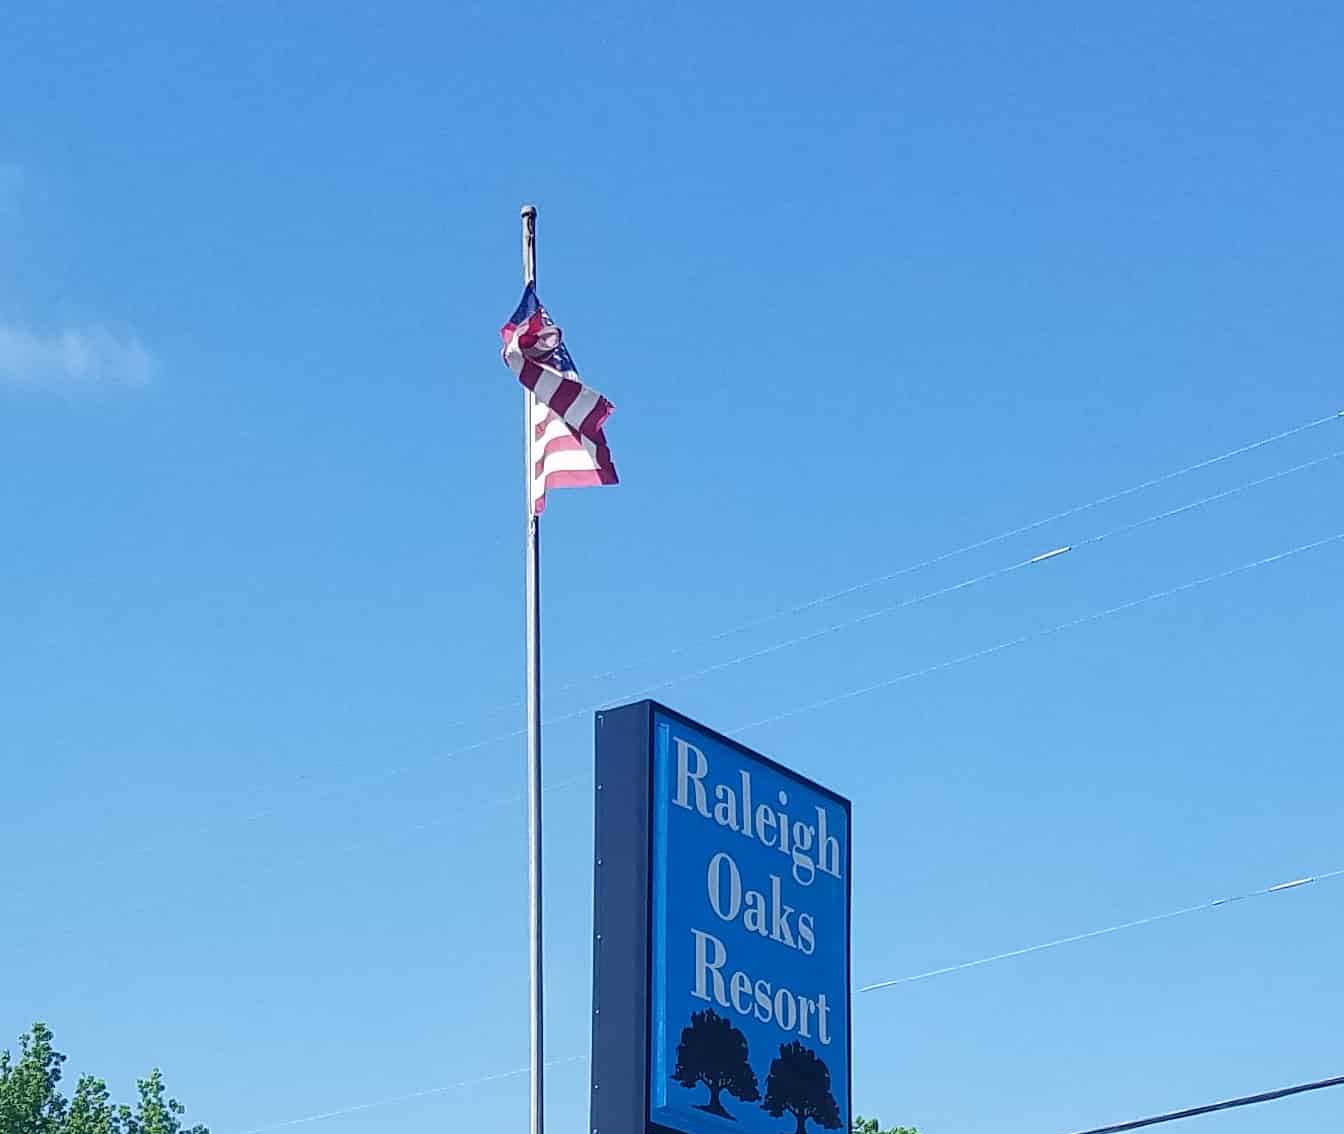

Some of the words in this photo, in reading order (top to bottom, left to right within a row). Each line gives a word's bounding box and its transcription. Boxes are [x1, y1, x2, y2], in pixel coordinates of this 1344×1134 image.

[672, 736, 842, 886] Raleigh
[707, 853, 816, 955] Oaks
[690, 929, 832, 1045] Resort
